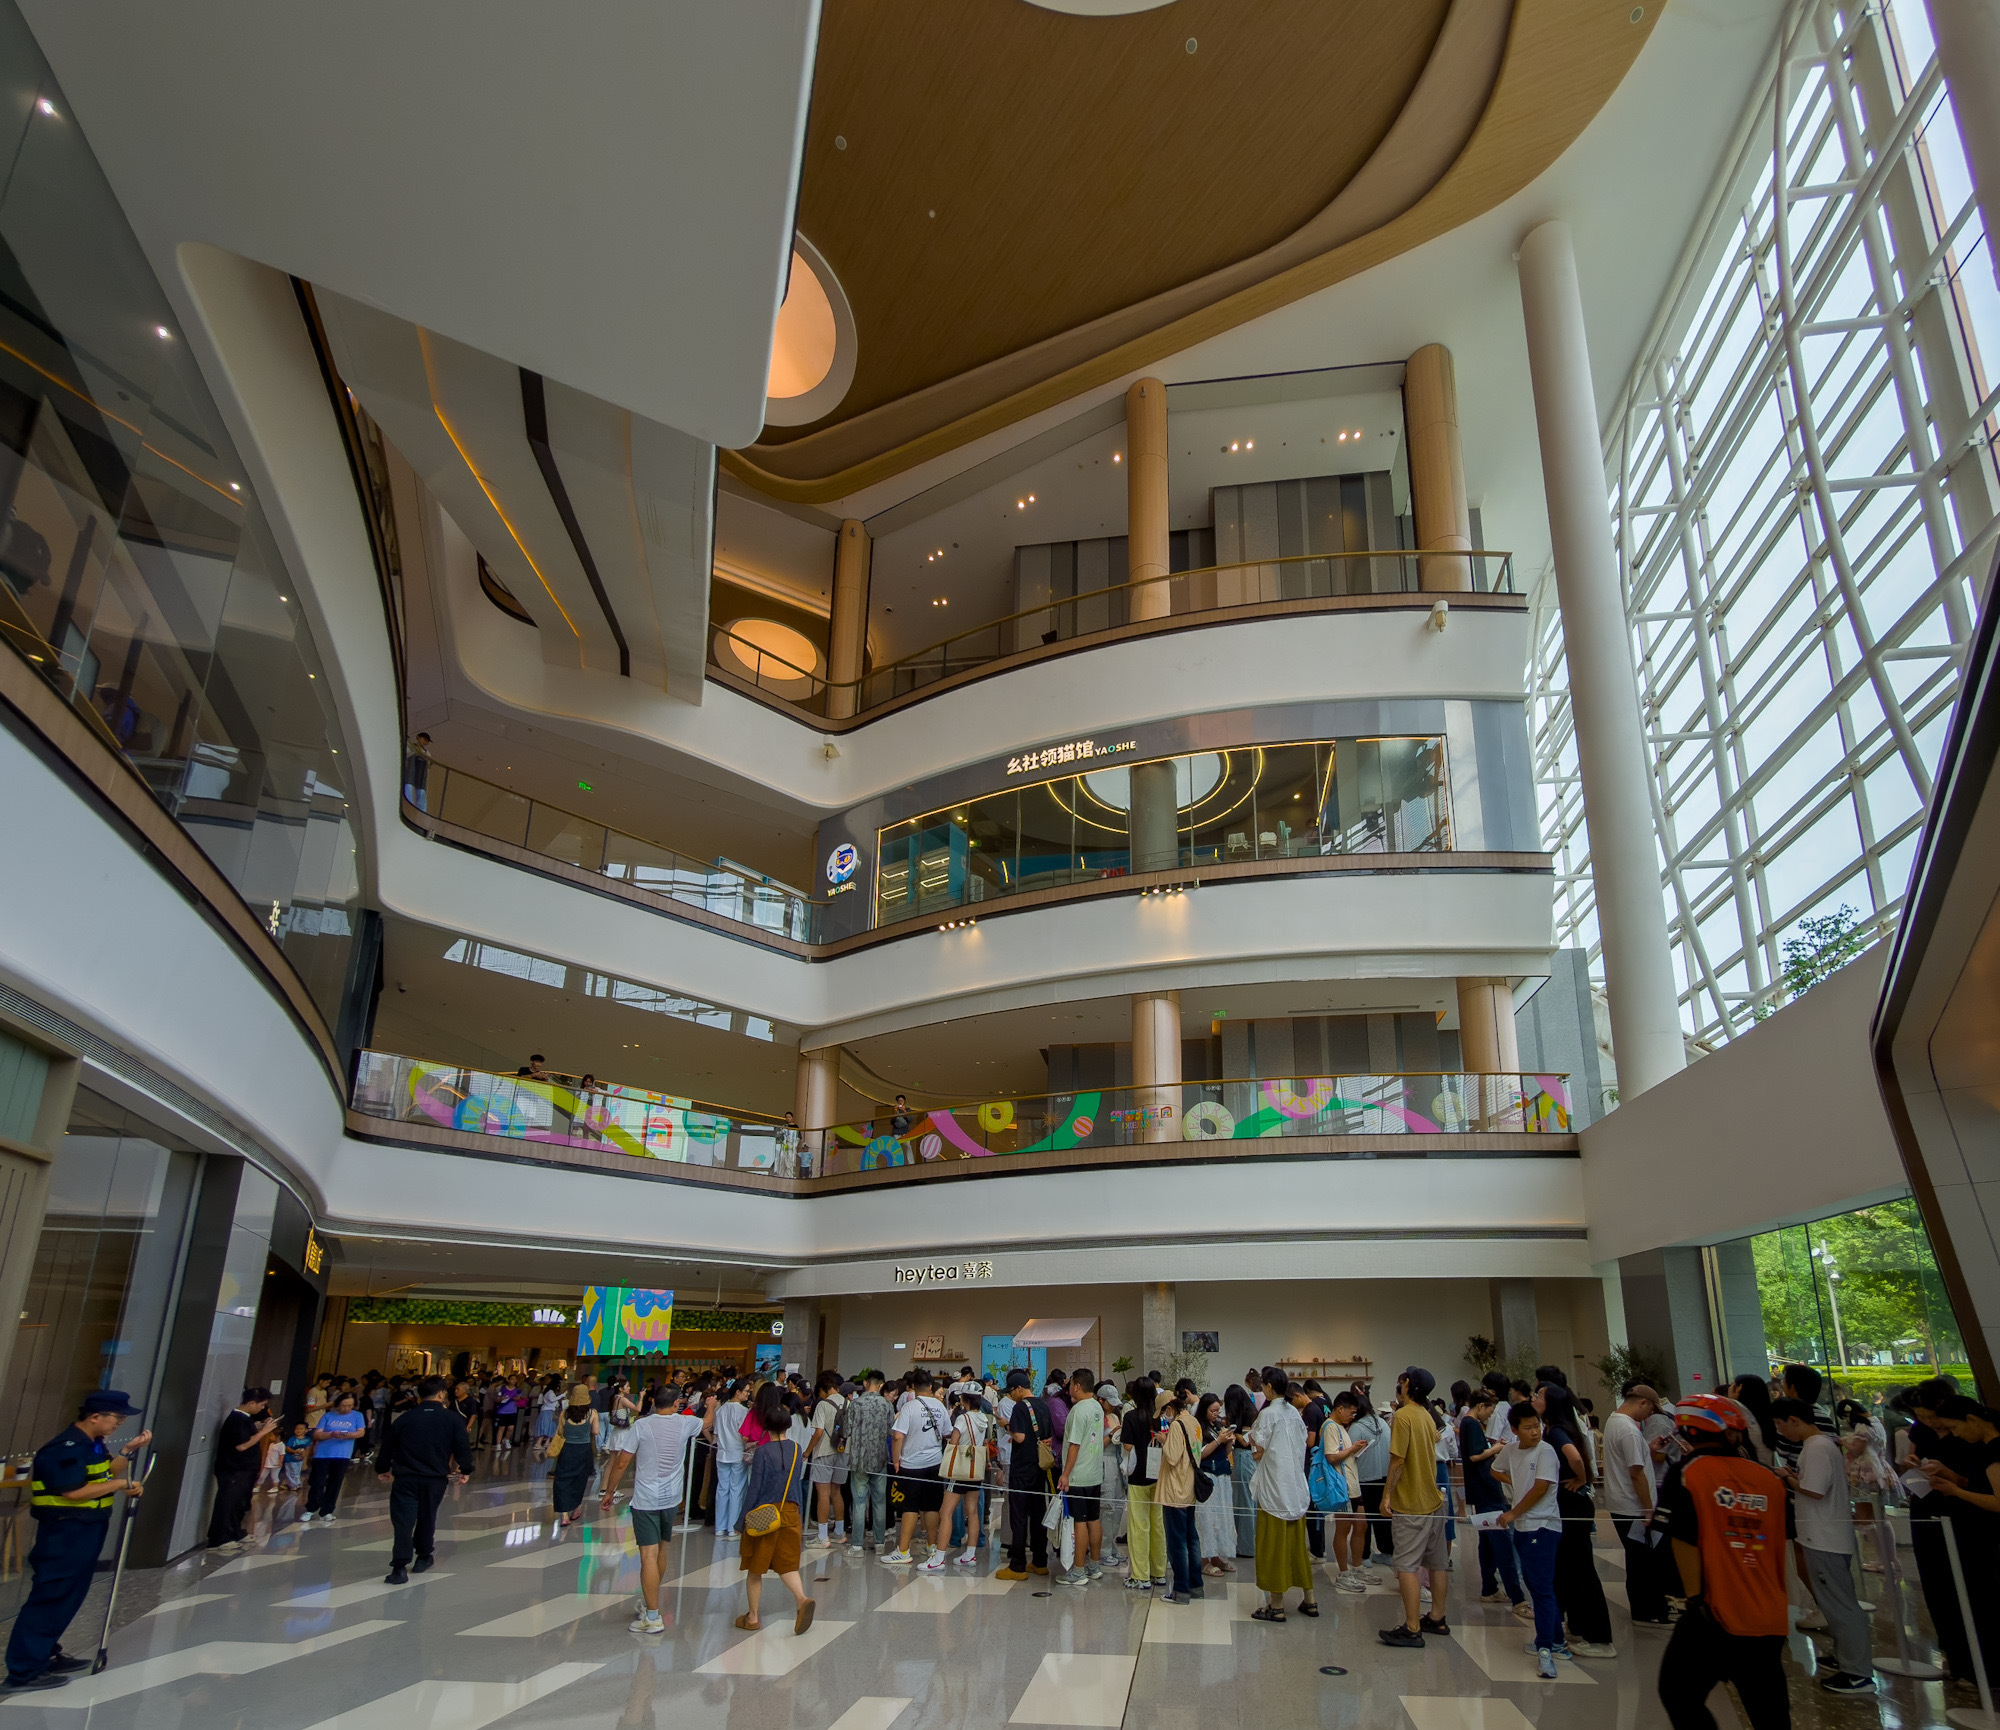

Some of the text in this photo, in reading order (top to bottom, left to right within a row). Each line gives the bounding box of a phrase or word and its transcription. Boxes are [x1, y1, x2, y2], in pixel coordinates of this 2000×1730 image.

[1094, 741, 1137, 756] YAOSHE
[827, 881, 855, 897] YAOSHE
[895, 1261, 993, 1285] heytea 喜茶
